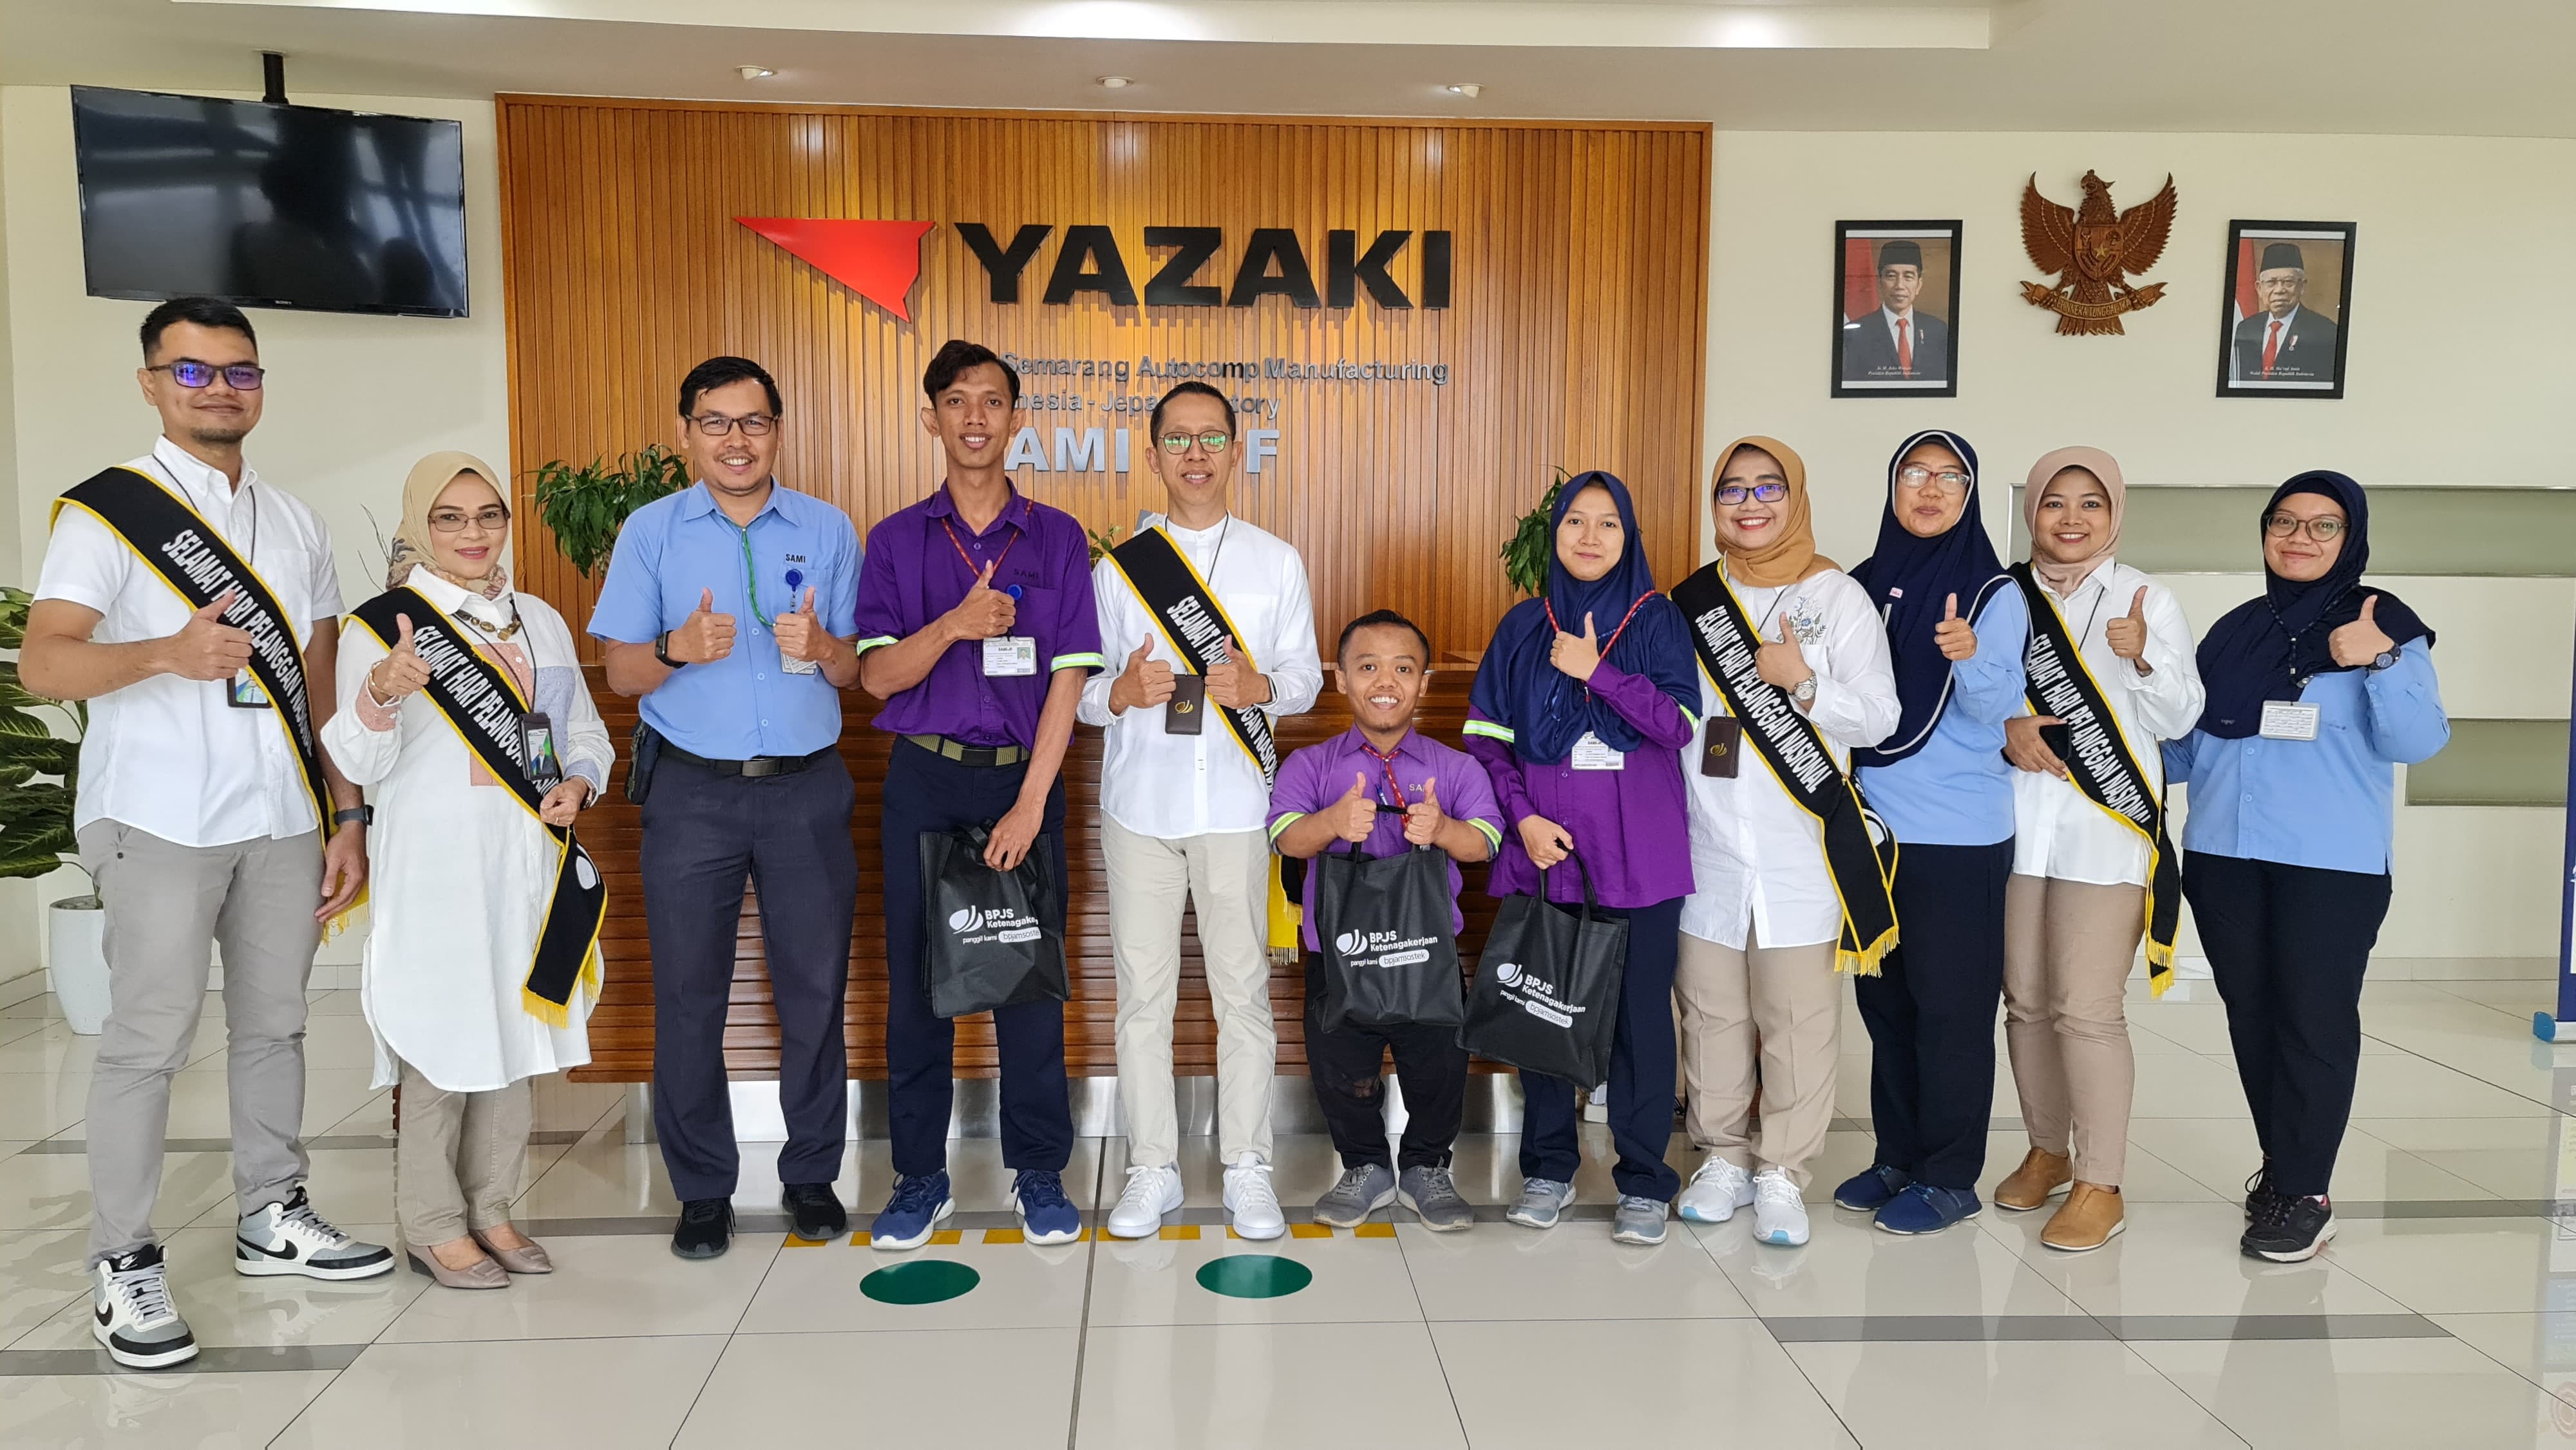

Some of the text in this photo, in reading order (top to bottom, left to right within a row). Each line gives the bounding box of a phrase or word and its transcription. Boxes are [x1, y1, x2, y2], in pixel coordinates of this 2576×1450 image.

[954, 222, 1451, 309] YAZAKI
[1002, 352, 1449, 385] Semarang Autocomp Manufacturing
[1014, 389, 1082, 410] nesia
[1101, 391, 1162, 416] Jepa
[1231, 394, 1281, 420] tory
[1004, 427, 1281, 474] AMI F
[786, 553, 806, 563] SAMI
[1014, 568, 1039, 579] SAMI
[162, 529, 232, 594] SELAMAT
[241, 609, 302, 697] PELANGGAN
[1167, 596, 1221, 648] SELAMAT
[442, 664, 492, 713] HARI
[1695, 605, 1833, 793] SELAMAT HARI PELANGGAN NASIONAL
[2041, 678, 2084, 719] HARI
[1409, 784, 1425, 793] SA
[985, 909, 1014, 920] BPJS
[963, 935, 983, 945] panggil
[1369, 930, 1397, 943] BPJS
[1370, 936, 1438, 952] Ketenagakerjaan
[1350, 959, 1366, 967] panggil
[1385, 952, 1426, 966] bpjamsostek
[1522, 984, 1586, 1013] Ketenagakerjaan
[1524, 974, 1553, 995] BPJS
[1500, 990, 1569, 1024] panggil kami bpjamsostek
